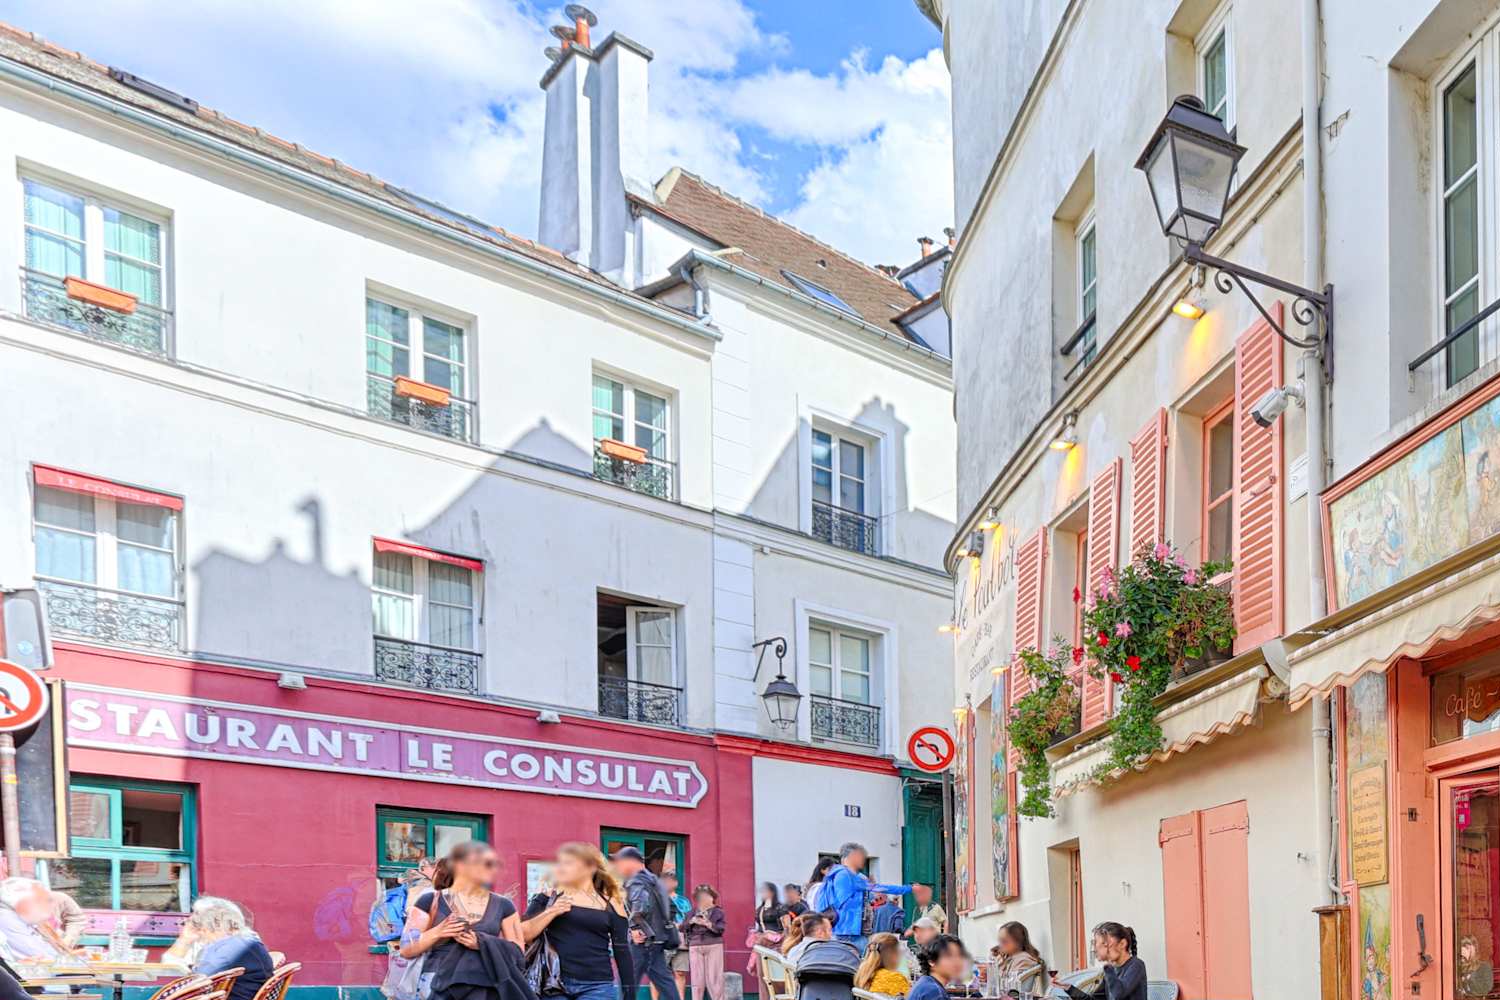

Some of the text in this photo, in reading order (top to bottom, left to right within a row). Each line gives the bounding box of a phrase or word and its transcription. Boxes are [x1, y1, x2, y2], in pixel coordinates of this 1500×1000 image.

[1446, 686, 1482, 719] Café
[68, 699, 692, 796] STAURANT LE CONSULAT
